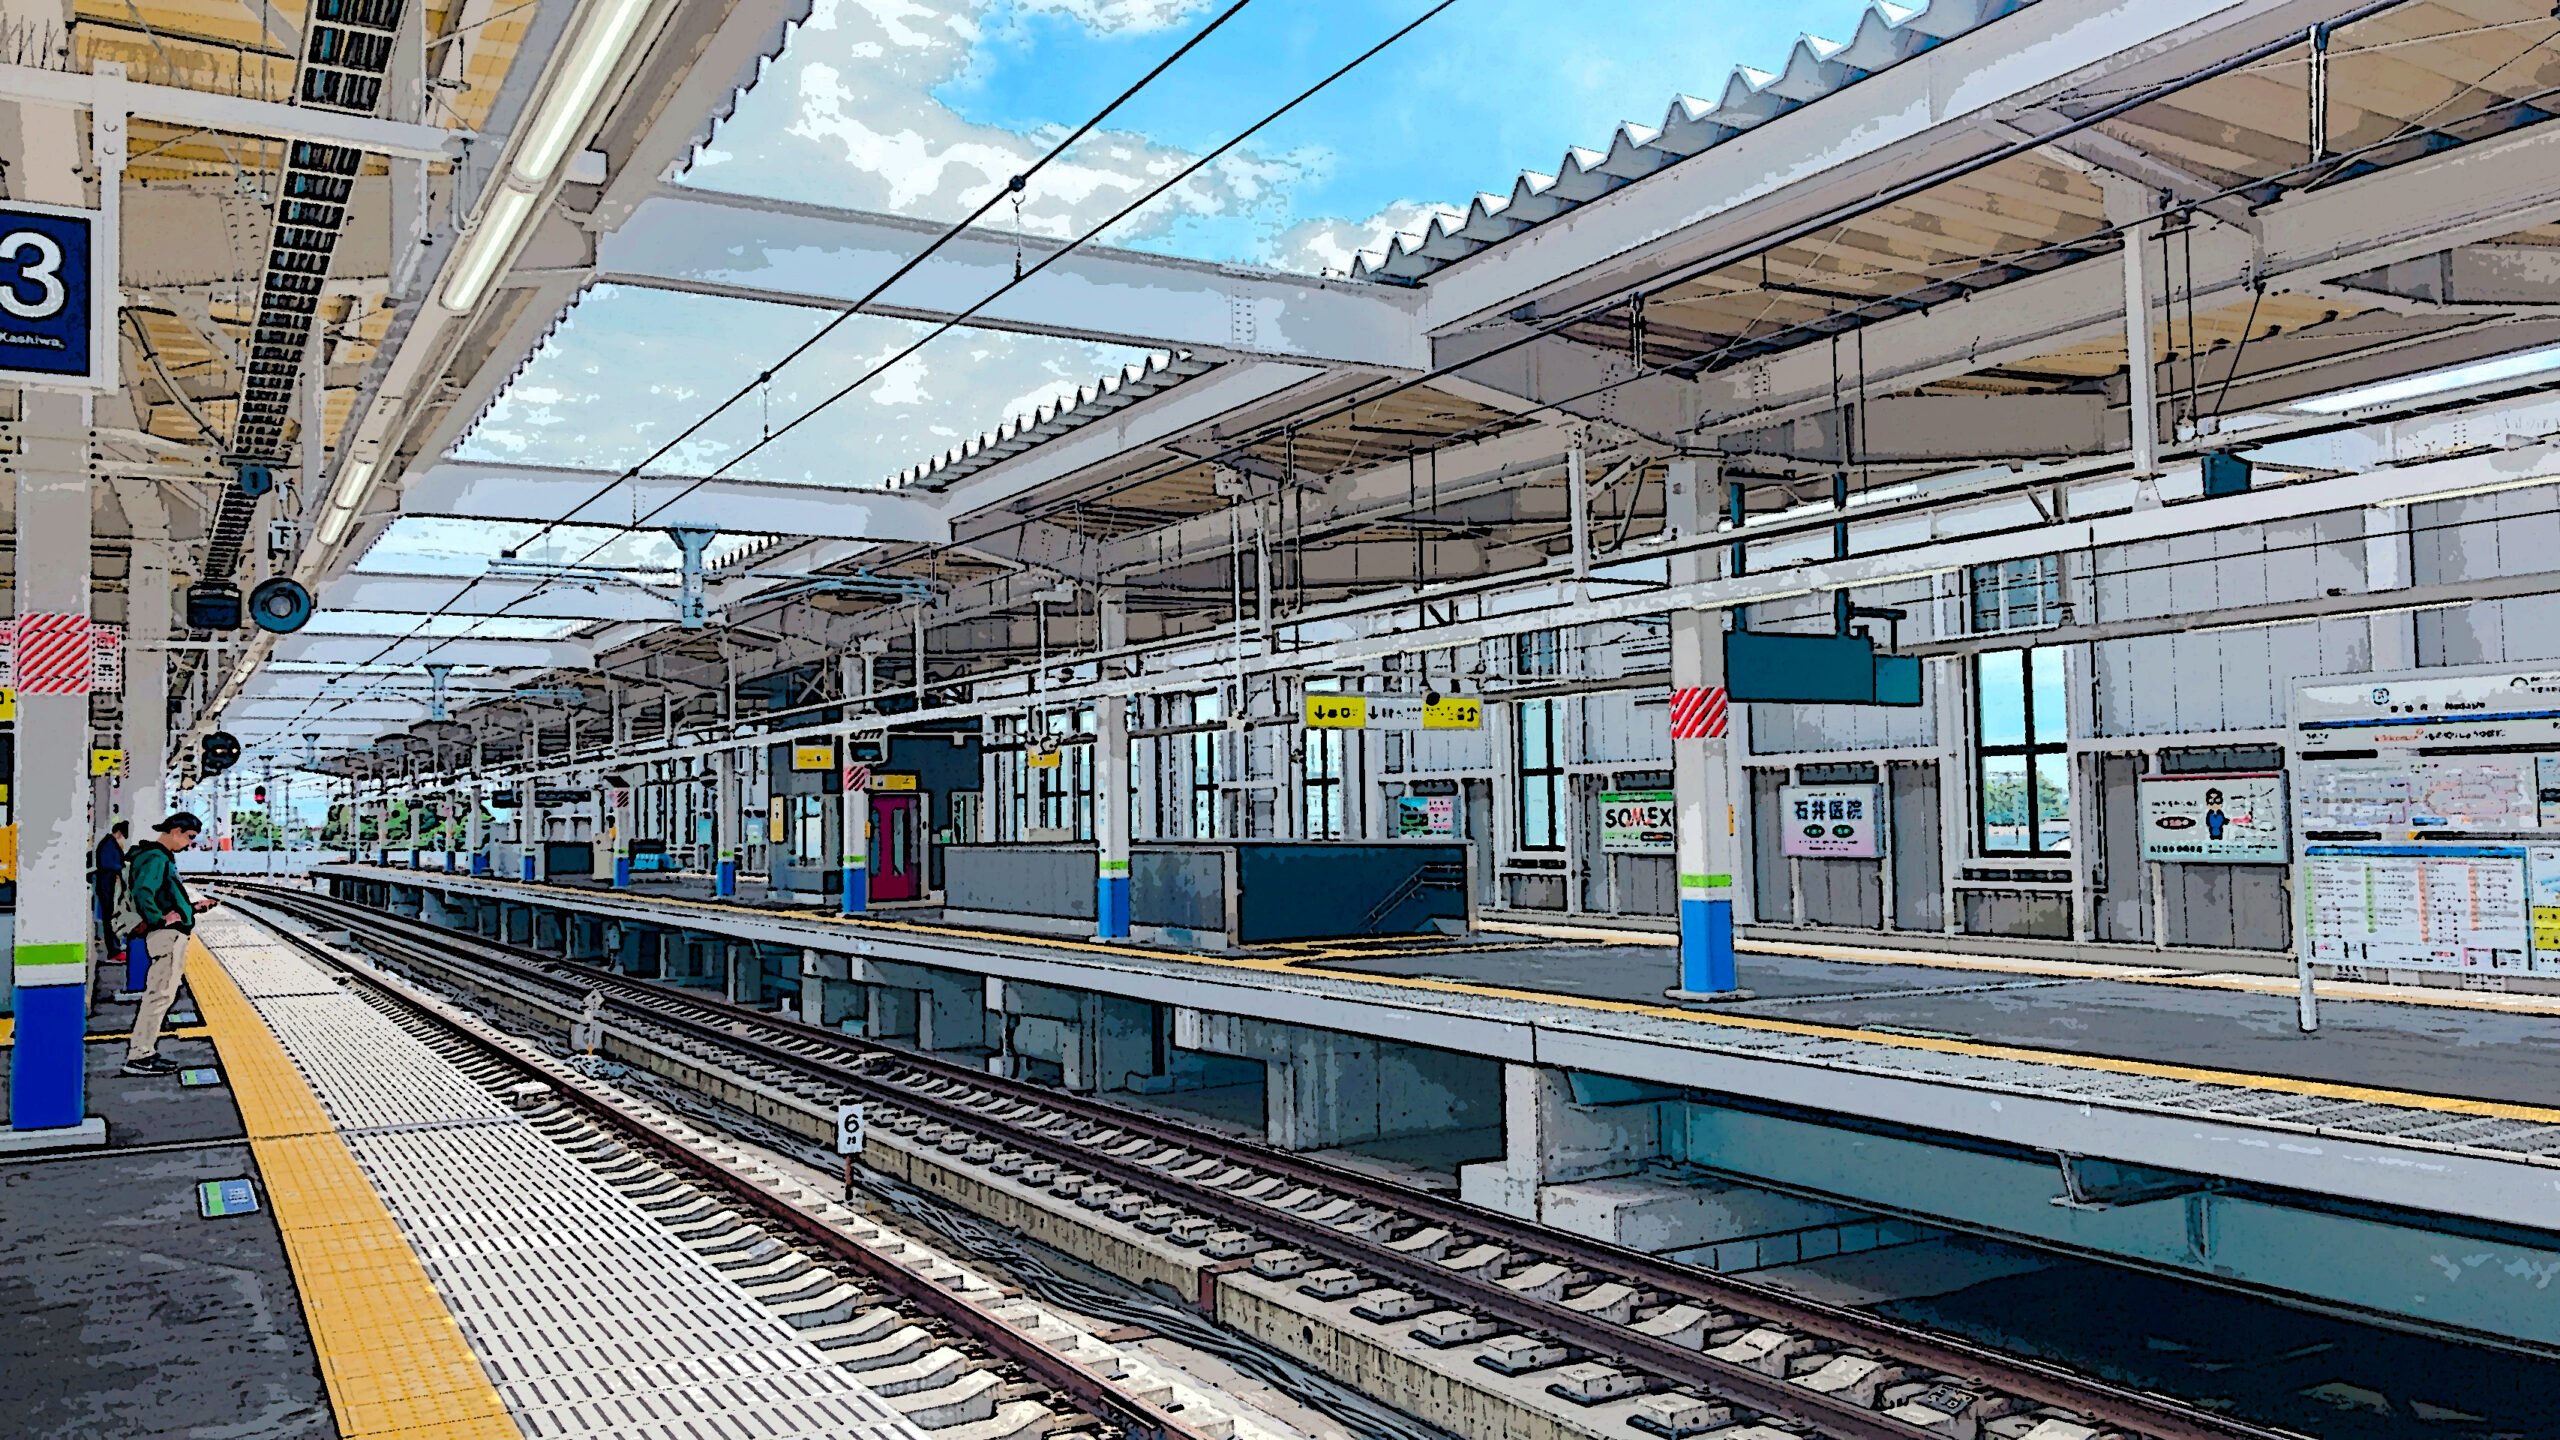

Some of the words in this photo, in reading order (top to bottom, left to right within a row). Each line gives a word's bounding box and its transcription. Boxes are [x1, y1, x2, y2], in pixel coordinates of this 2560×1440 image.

[0, 231, 65, 318] 3
[1604, 806, 1672, 829] SOMEX
[1794, 800, 1863, 820] 石井医院
[844, 1113, 860, 1133] 6
